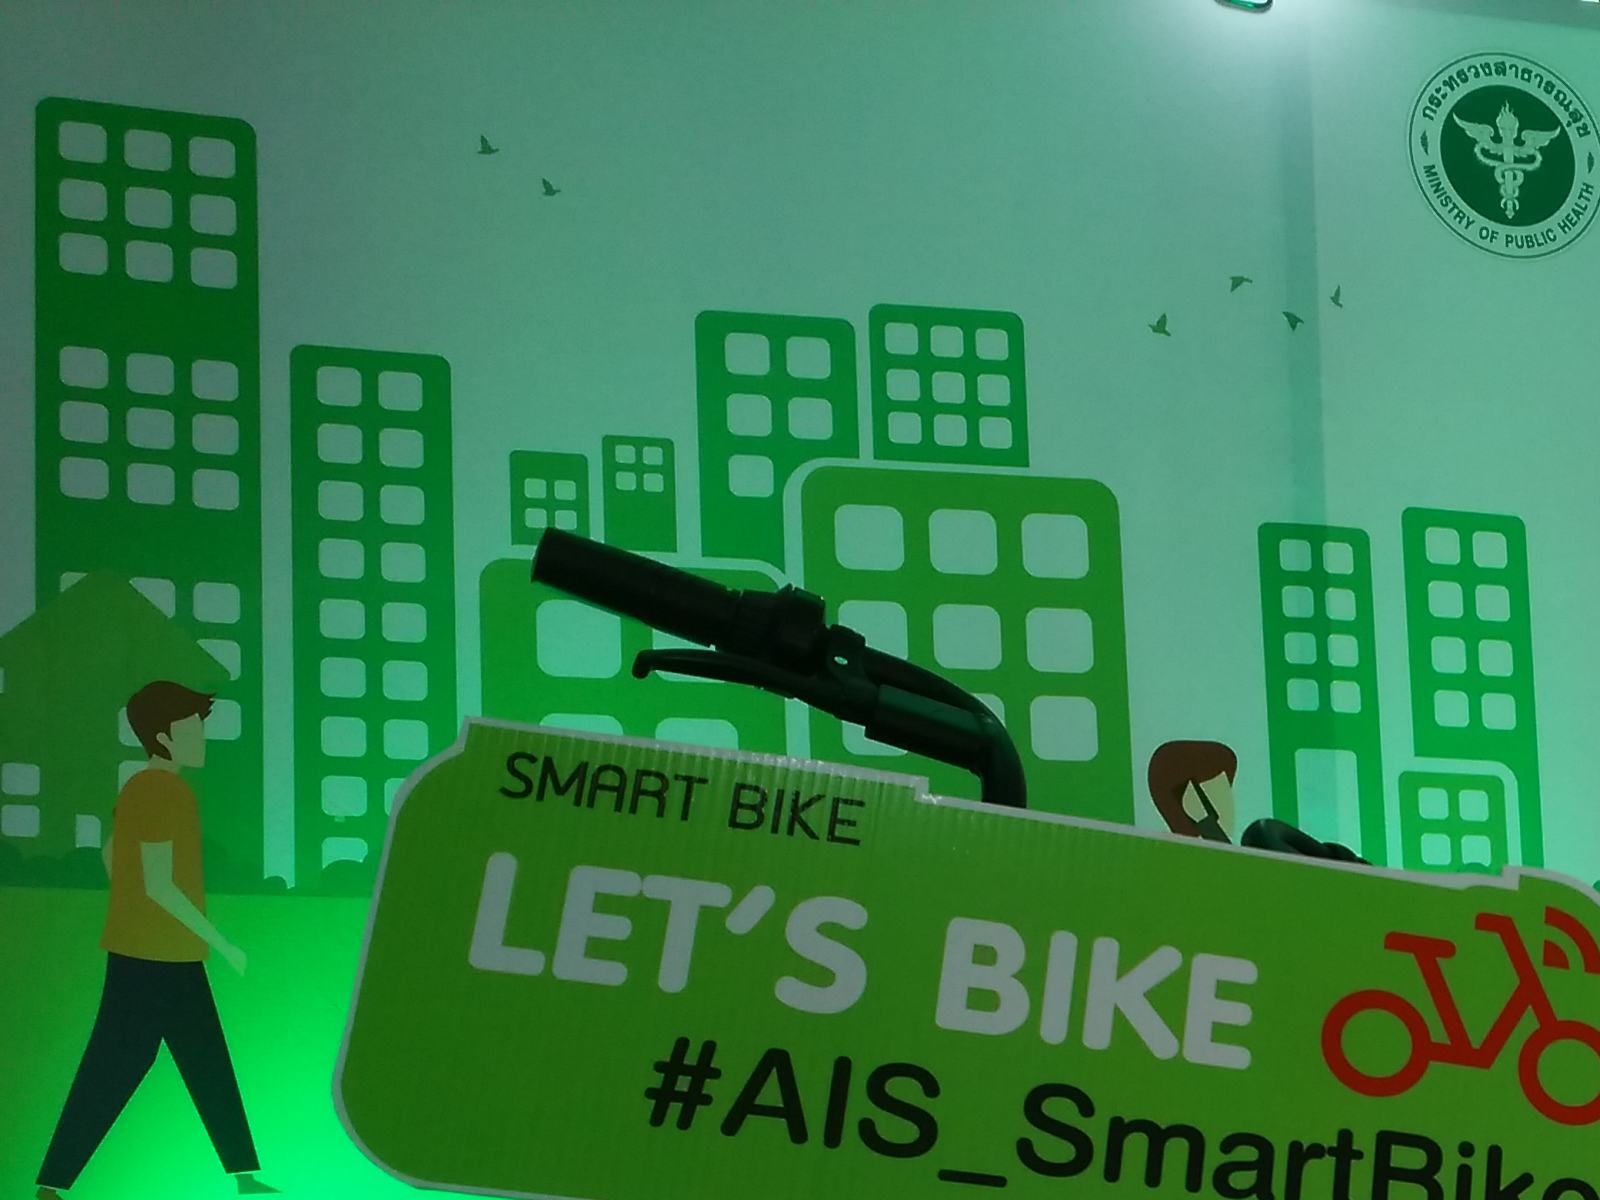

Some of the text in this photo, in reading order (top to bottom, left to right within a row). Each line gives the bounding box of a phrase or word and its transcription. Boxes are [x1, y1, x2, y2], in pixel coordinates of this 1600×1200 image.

[1422, 61, 1591, 138] กระทรวงสาธารณสุข
[1423, 164, 1594, 249] MINISTRY OF PUBLIC HEALTH
[499, 751, 866, 846] SMART BIKE
[467, 852, 1258, 1070] LET'S BIKE
